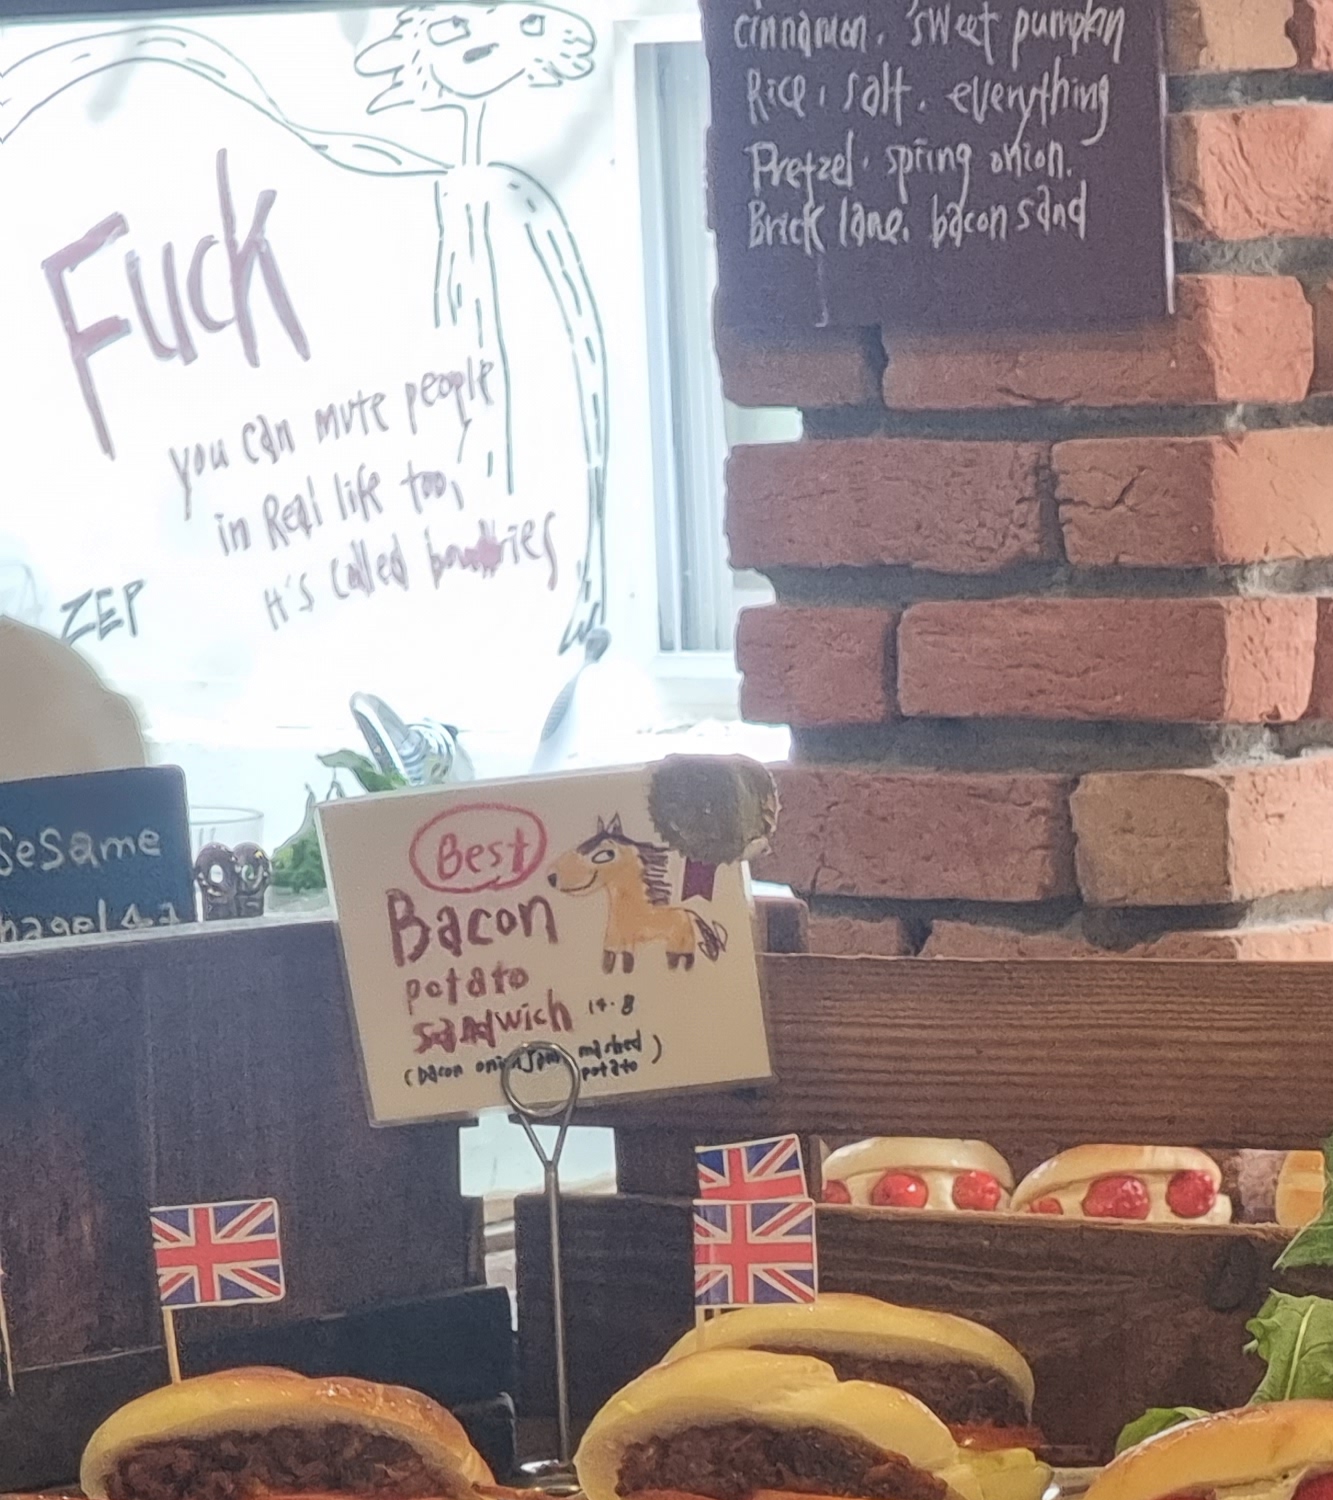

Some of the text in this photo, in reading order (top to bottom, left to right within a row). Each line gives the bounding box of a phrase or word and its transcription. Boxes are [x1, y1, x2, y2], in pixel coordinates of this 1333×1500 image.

[911, 2, 999, 66] sweet
[1012, 0, 1125, 71] pumpkin
[946, 56, 1109, 146] everything
[887, 138, 972, 204] spring
[748, 199, 825, 255] Brick
[930, 194, 1007, 248] bacon
[1018, 181, 1086, 240] sand
[41, 147, 311, 461] Fuck
[168, 356, 495, 520] you can mute people
[214, 512, 251, 556] in
[333, 462, 384, 521] life
[330, 532, 410, 598] called
[59, 579, 146, 645] ZEP
[436, 827, 530, 881] Best
[385, 887, 559, 968] Bacon
[405, 960, 530, 1015] potato
[412, 988, 575, 1054] sandwich
